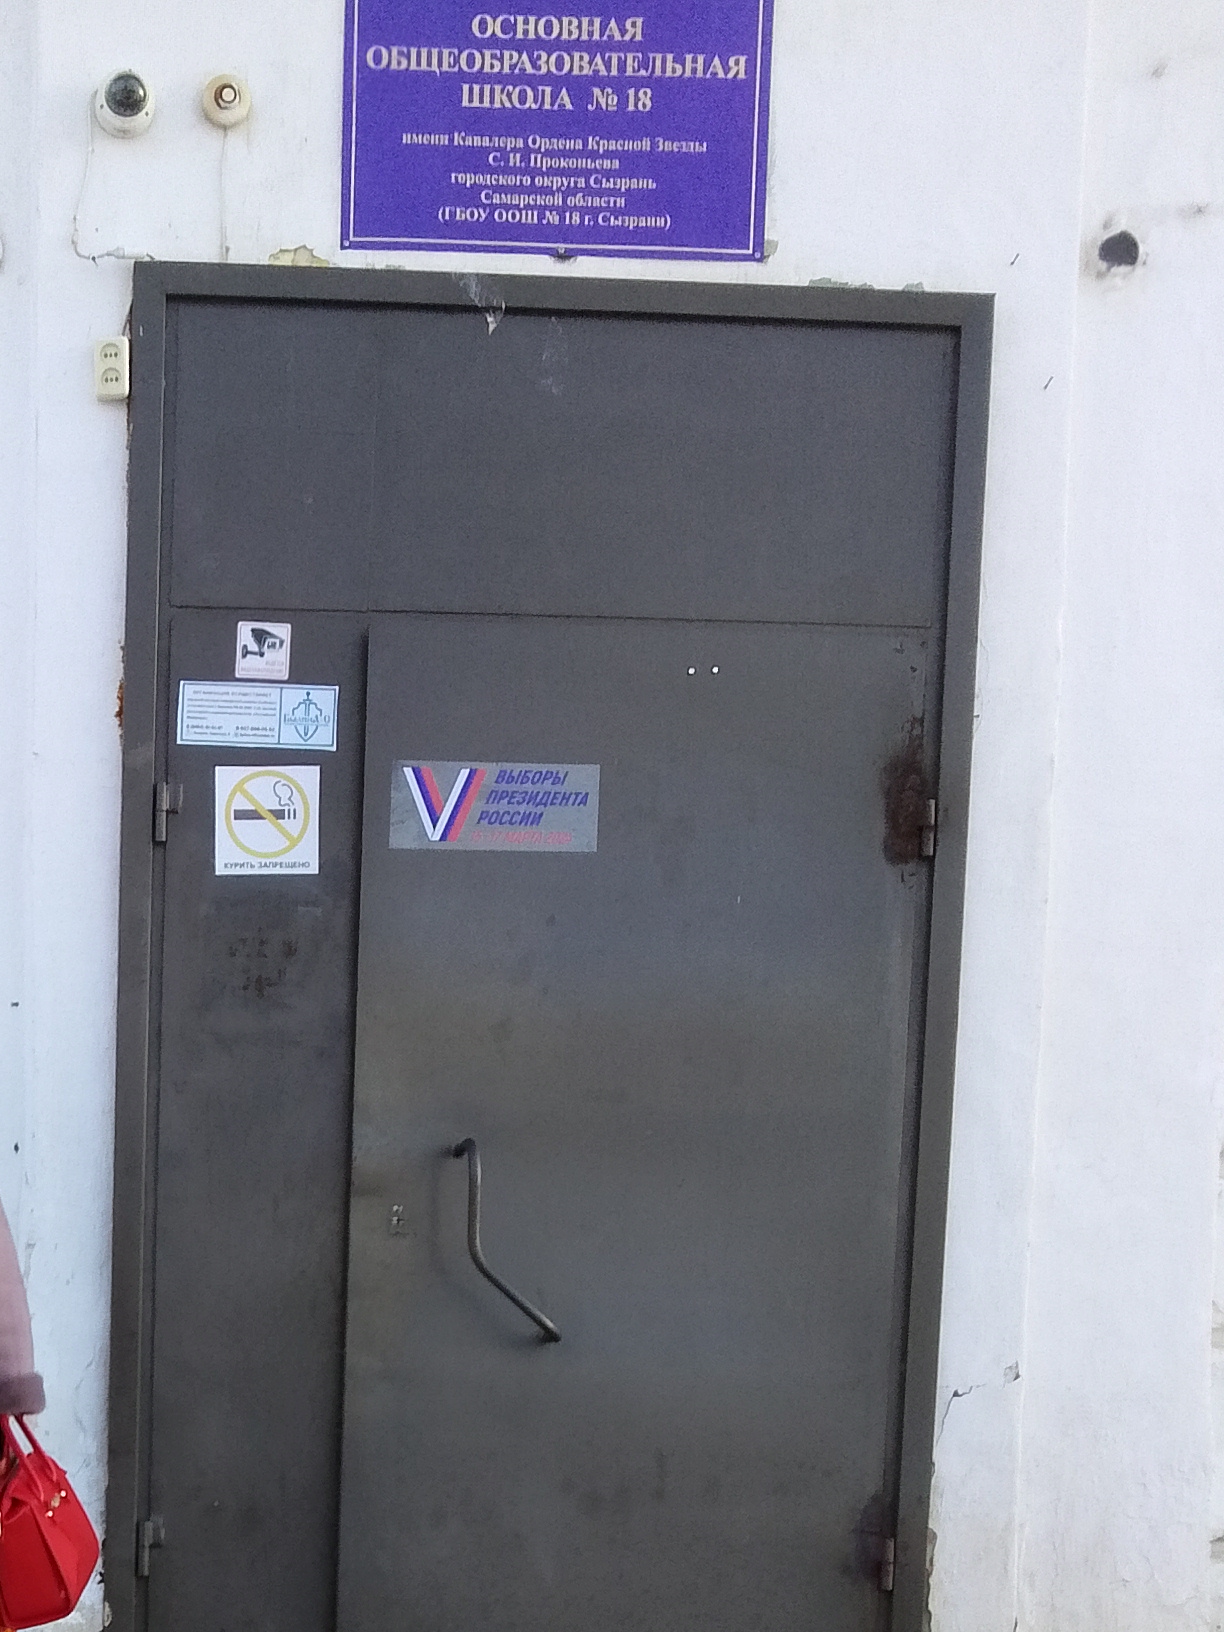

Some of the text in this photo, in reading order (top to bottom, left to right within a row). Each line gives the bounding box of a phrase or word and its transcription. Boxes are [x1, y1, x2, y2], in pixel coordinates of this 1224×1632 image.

[471, 14, 643, 41] ОСНОВНАЯ
[366, 45, 748, 79] ОБЩЕОБРАЗОВАТЕЛЬНАЯ
[461, 83, 653, 112] ШКОЛА № 18
[402, 131, 707, 154] имени Кавалера Ордена Красной Звезды
[488, 152, 505, 167] С.
[509, 153, 525, 167] И.
[450, 172, 657, 192] городского округа Сызрань
[480, 190, 626, 208] Самарской области
[438, 205, 489, 224] (ГБОУ
[494, 208, 539, 225] ООШ
[565, 211, 580, 225] 18
[494, 769, 569, 786] ВЫБОРЫ
[484, 789, 590, 808] ПРЕЗИДЕНТА
[476, 809, 544, 827] РОССИИ
[257, 861, 311, 869] ЗАПРЕЩЕНО
